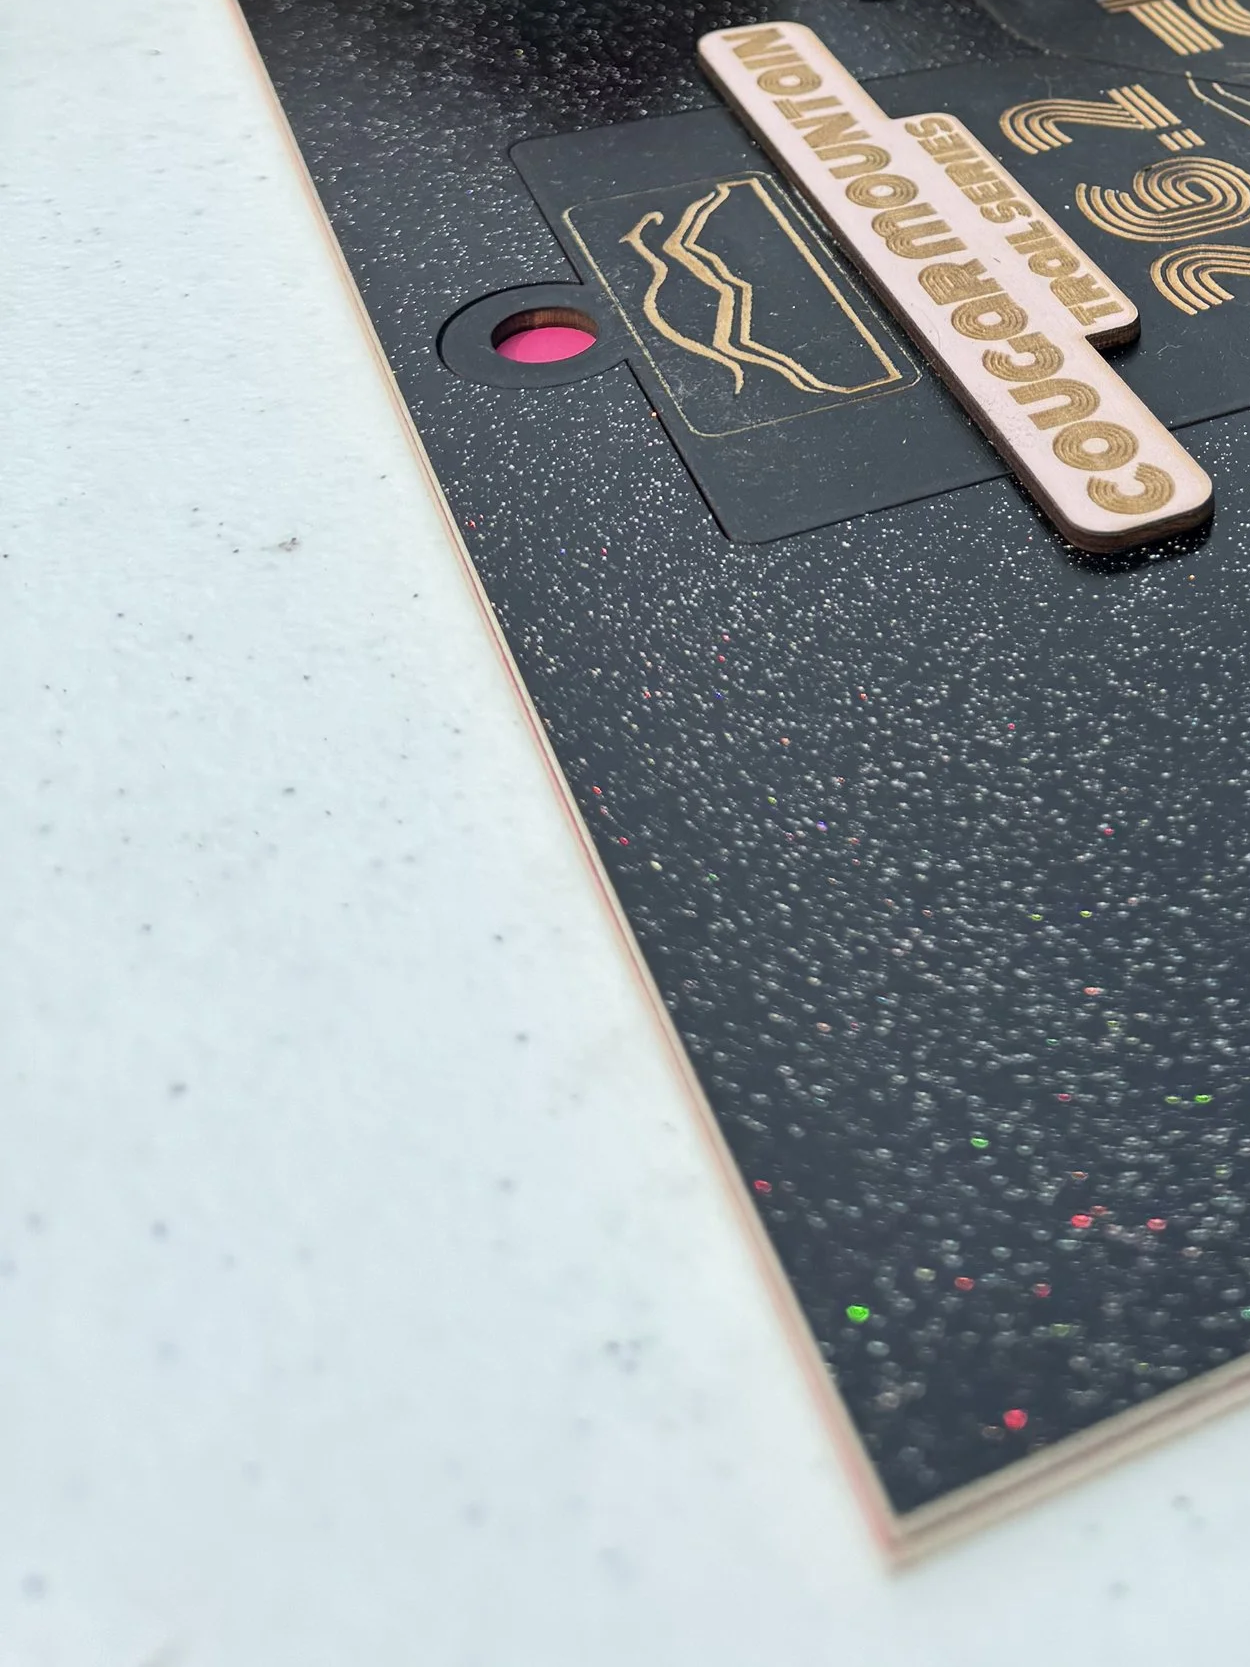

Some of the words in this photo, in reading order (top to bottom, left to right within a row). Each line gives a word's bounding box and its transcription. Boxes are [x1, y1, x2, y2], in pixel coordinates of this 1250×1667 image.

[722, 27, 969, 260] MOUNTAIN
[905, 117, 1032, 224] SERIES
[1005, 220, 1124, 326] TRAIL
[918, 257, 1175, 516] COUGAR
